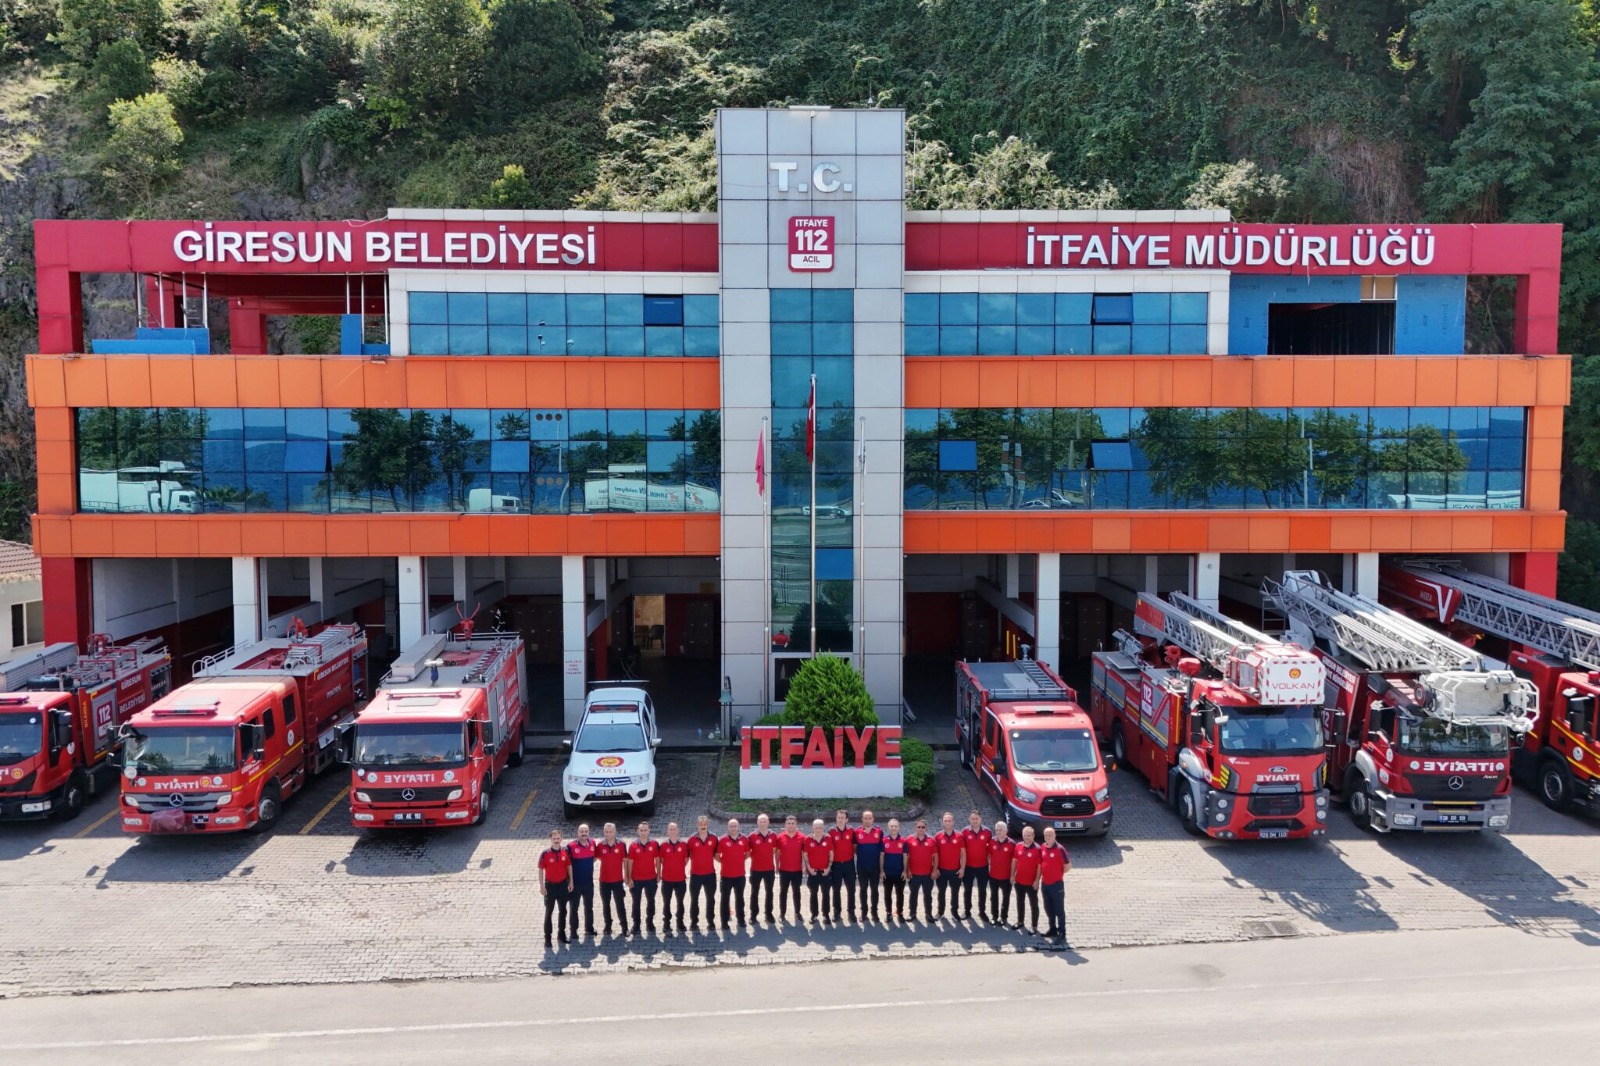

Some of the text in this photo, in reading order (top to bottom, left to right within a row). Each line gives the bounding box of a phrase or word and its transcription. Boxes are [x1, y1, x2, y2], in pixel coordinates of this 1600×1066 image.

[769, 161, 853, 193] T.C.
[173, 221, 597, 265] GİRESUN BELEDİYESİ
[795, 229, 828, 251] 112
[1026, 226, 1435, 267] İTFAİYE MÜDÜRLÜĞÜ
[1143, 684, 1152, 704] 112
[1272, 682, 1315, 690] VOLKAN
[99, 704, 110, 724] 112
[740, 725, 902, 769] İTFAİYE
